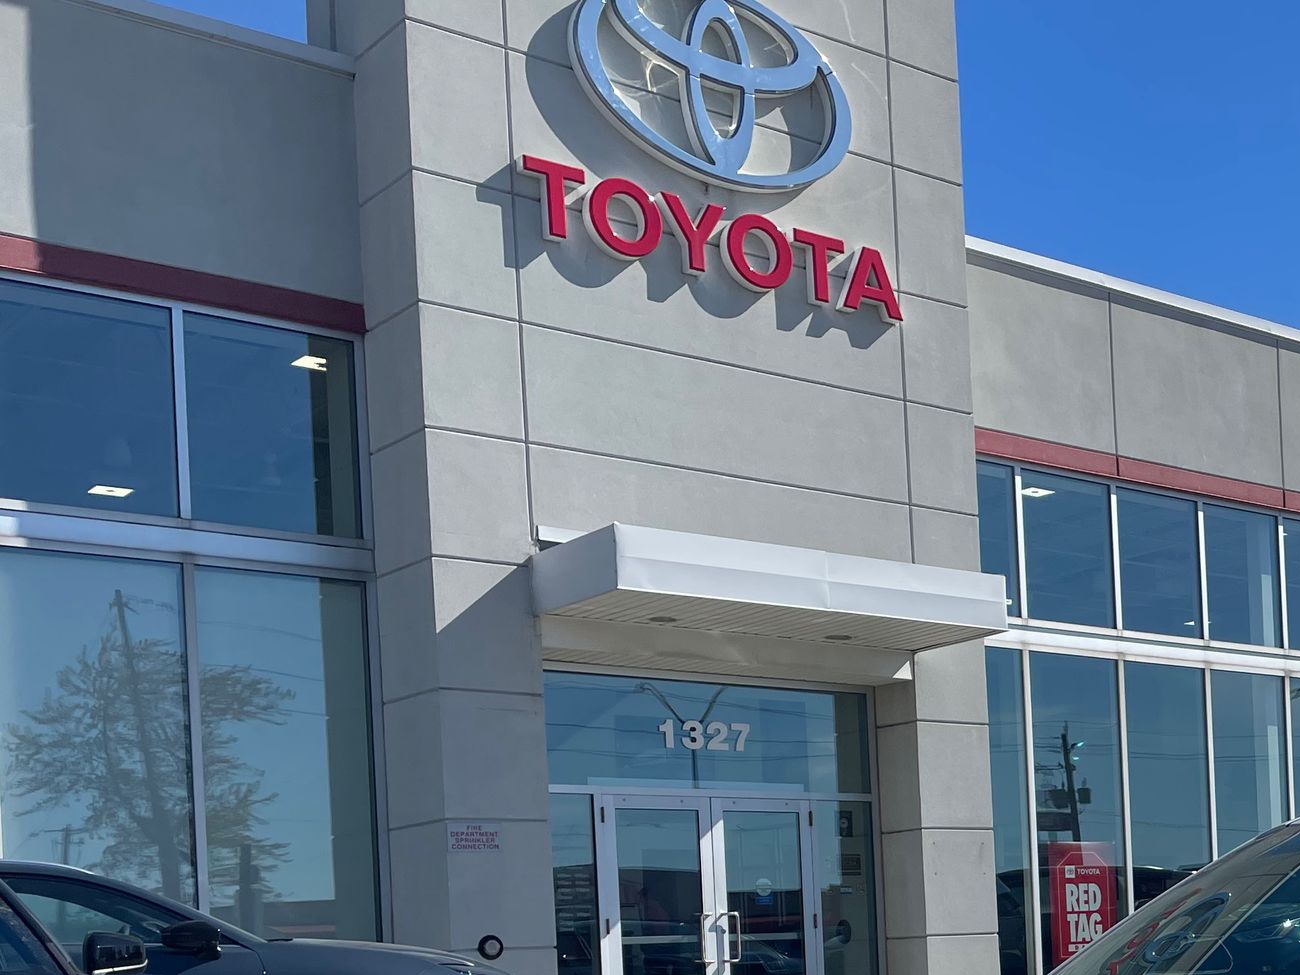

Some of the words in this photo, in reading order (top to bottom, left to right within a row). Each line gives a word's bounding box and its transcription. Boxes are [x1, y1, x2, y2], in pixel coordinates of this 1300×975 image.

[518, 154, 903, 323] TOYOTA
[658, 719, 750, 752] 1327
[1076, 868, 1101, 876] TOYOTA
[1065, 883, 1102, 912] RED
[1066, 912, 1103, 943] TAG
